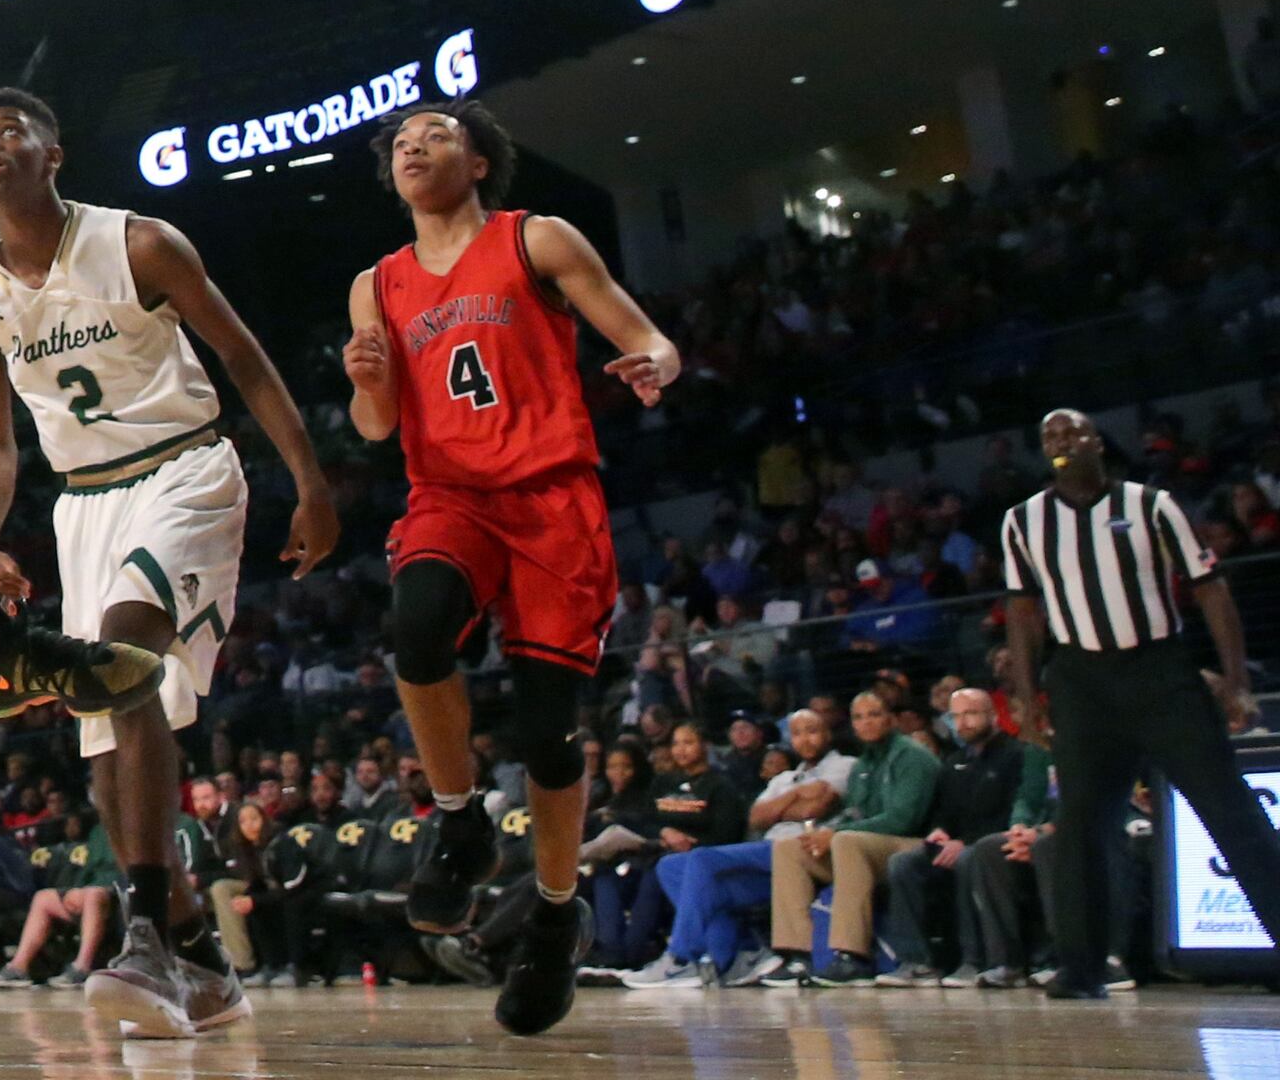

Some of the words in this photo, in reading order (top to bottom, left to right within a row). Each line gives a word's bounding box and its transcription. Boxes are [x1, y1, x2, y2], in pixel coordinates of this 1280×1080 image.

[208, 63, 421, 162] GATORADE
[12, 318, 117, 365] Panthers
[57, 365, 119, 426] 2
[446, 340, 499, 411] 4
